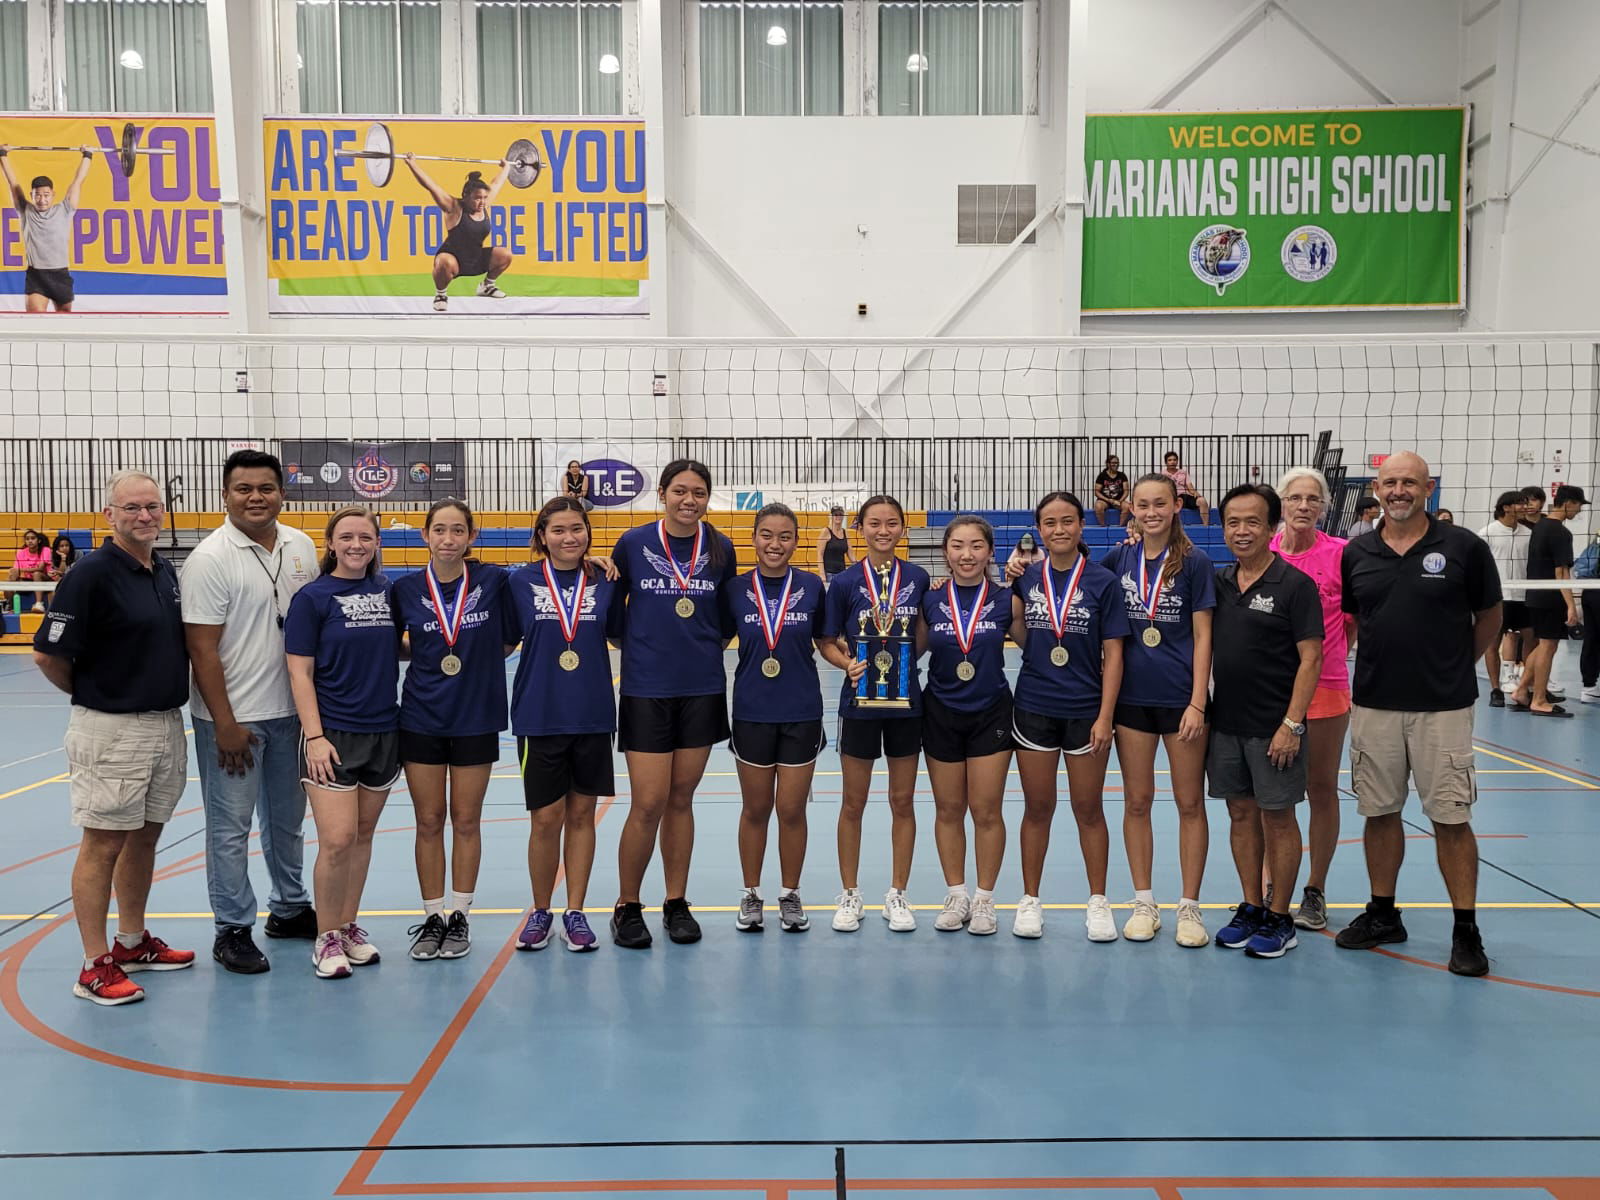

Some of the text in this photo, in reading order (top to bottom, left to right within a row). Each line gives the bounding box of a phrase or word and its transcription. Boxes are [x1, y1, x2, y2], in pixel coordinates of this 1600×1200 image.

[1168, 123, 1362, 148] WELCOME TO
[271, 129, 358, 192] ARE
[540, 130, 646, 193] YOU
[1083, 154, 1451, 218] MARIANAS HIGH SCHOOL
[271, 199, 648, 262] READY TO BE LIFTED
[436, 463, 452, 472] FIBA
[580, 469, 636, 497] T&E
[640, 578, 715, 591] GCA EGLES
